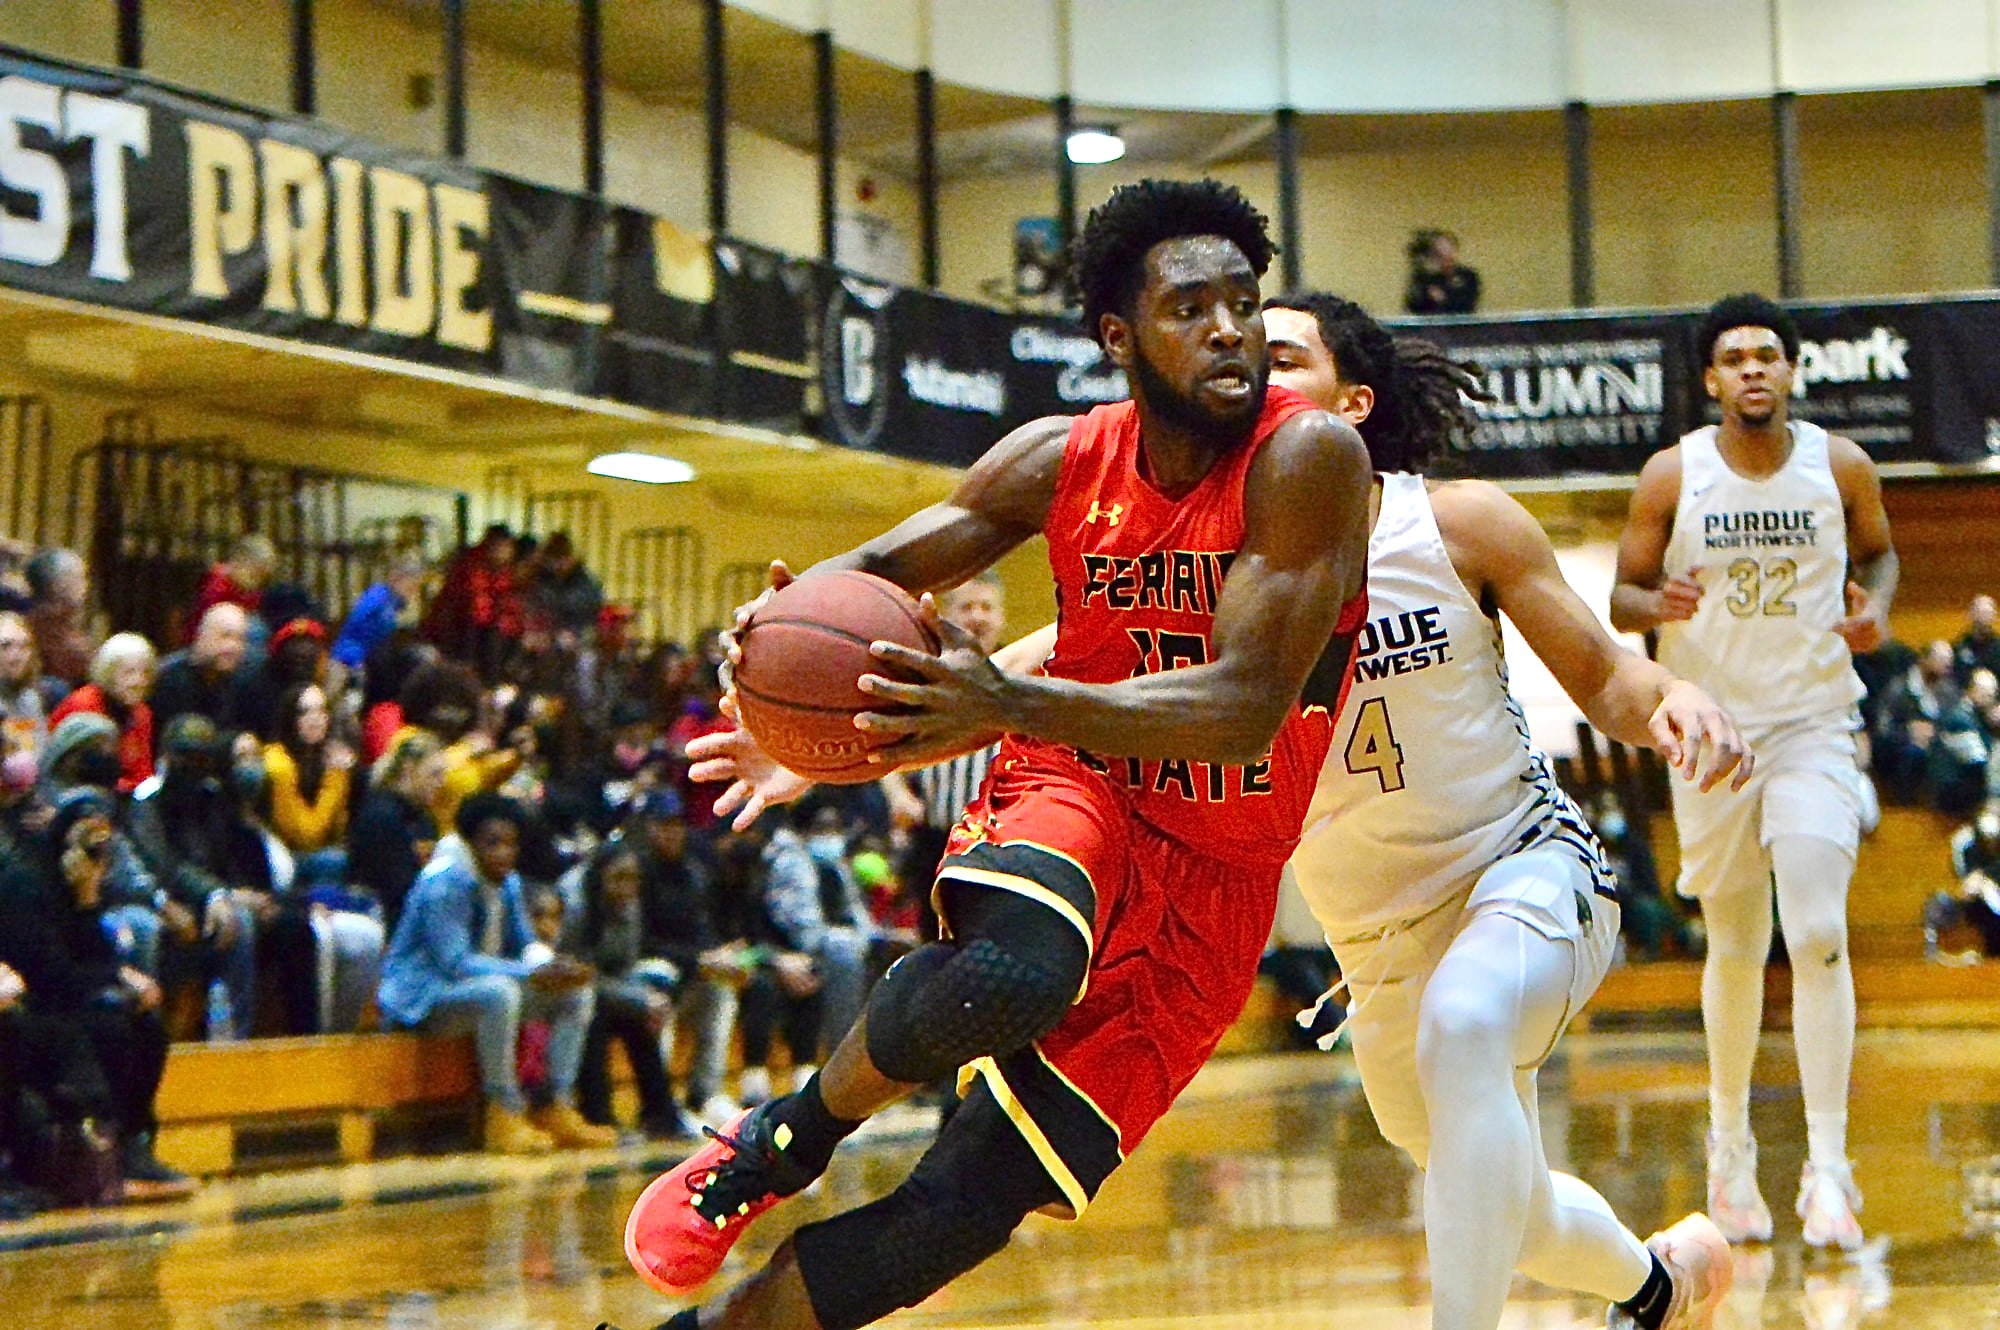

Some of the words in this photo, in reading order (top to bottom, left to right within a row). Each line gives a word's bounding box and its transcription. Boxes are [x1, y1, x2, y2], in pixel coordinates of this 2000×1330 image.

[185, 119, 494, 353] PRIDE
[1704, 509, 1817, 533] PURDUE
[1705, 530, 1817, 549] NORTHWEST
[1726, 556, 1798, 620] 32
[1344, 696, 1405, 793] 4
